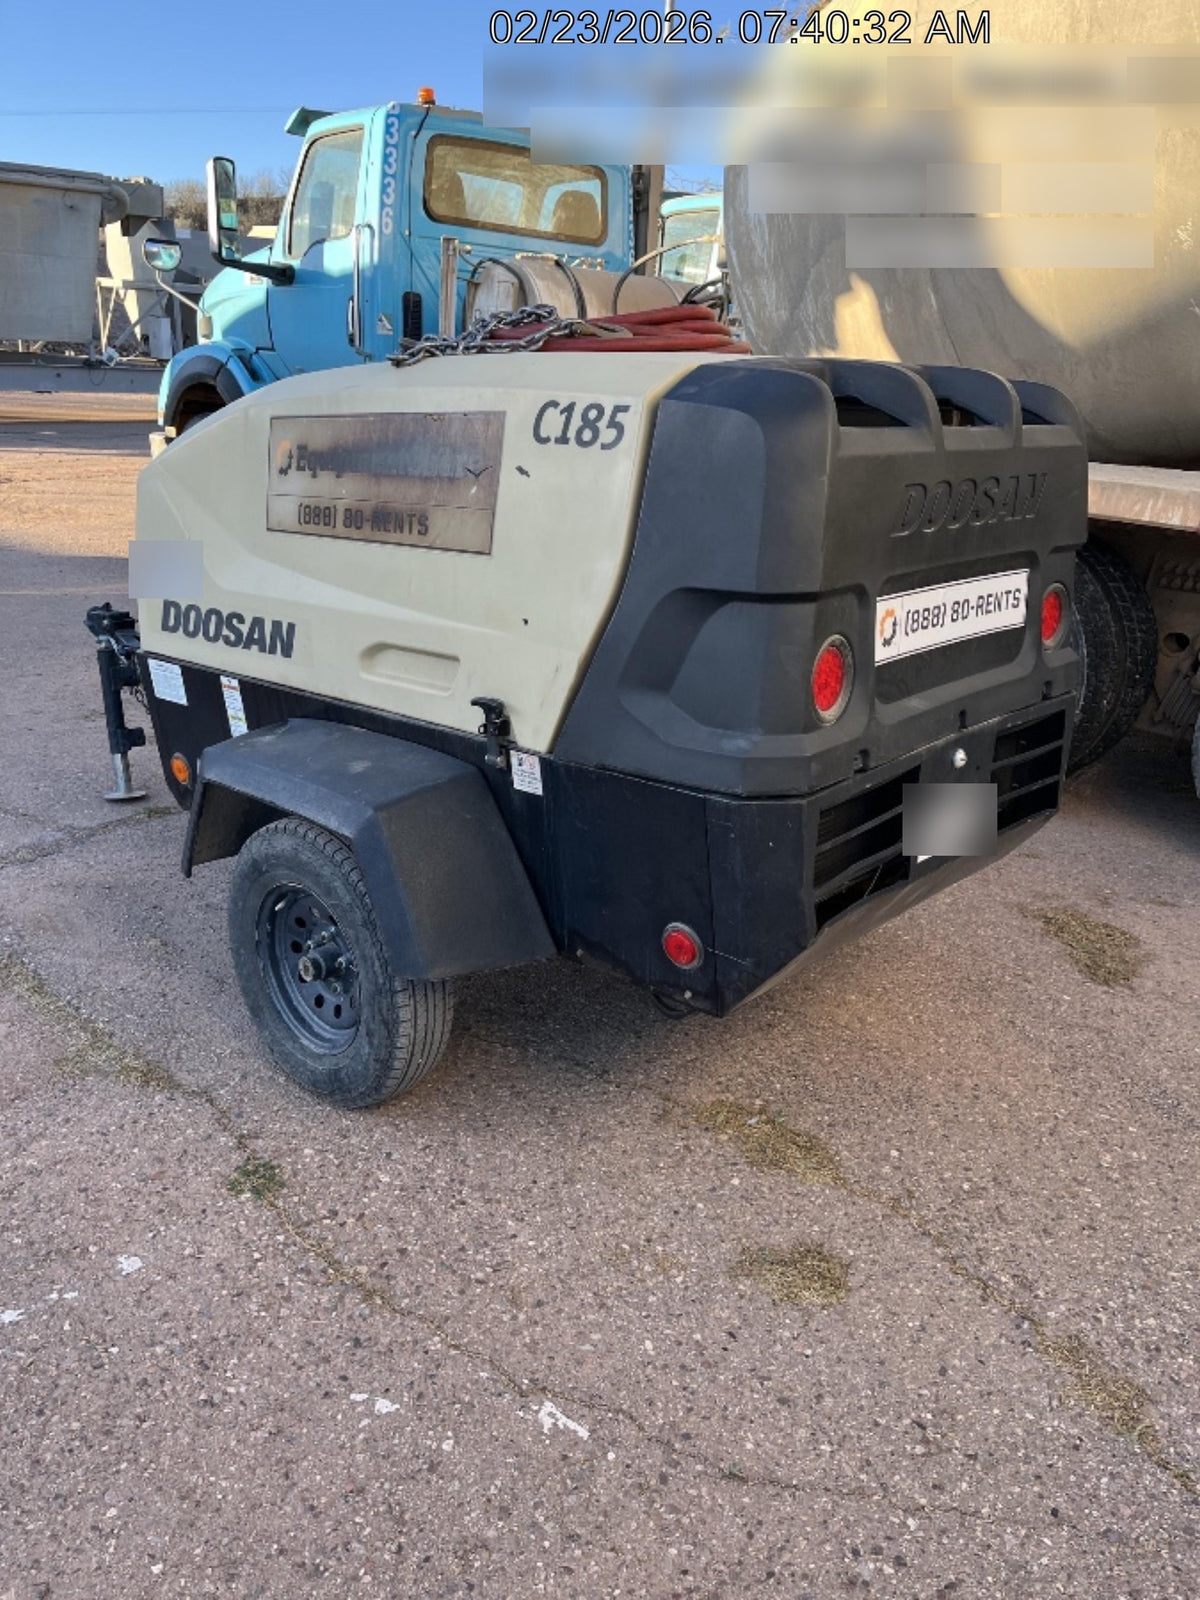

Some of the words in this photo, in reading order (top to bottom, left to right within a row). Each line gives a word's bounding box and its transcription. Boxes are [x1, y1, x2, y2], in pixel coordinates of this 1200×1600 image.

[532, 399, 632, 451] C185
[298, 503, 337, 529] (888)
[342, 507, 430, 536] 80-RENTS
[889, 472, 1049, 538] DOOSAN
[160, 599, 297, 659] DOOSAN
[904, 602, 947, 637] (888)
[950, 588, 1022, 623] 80-RENTS
